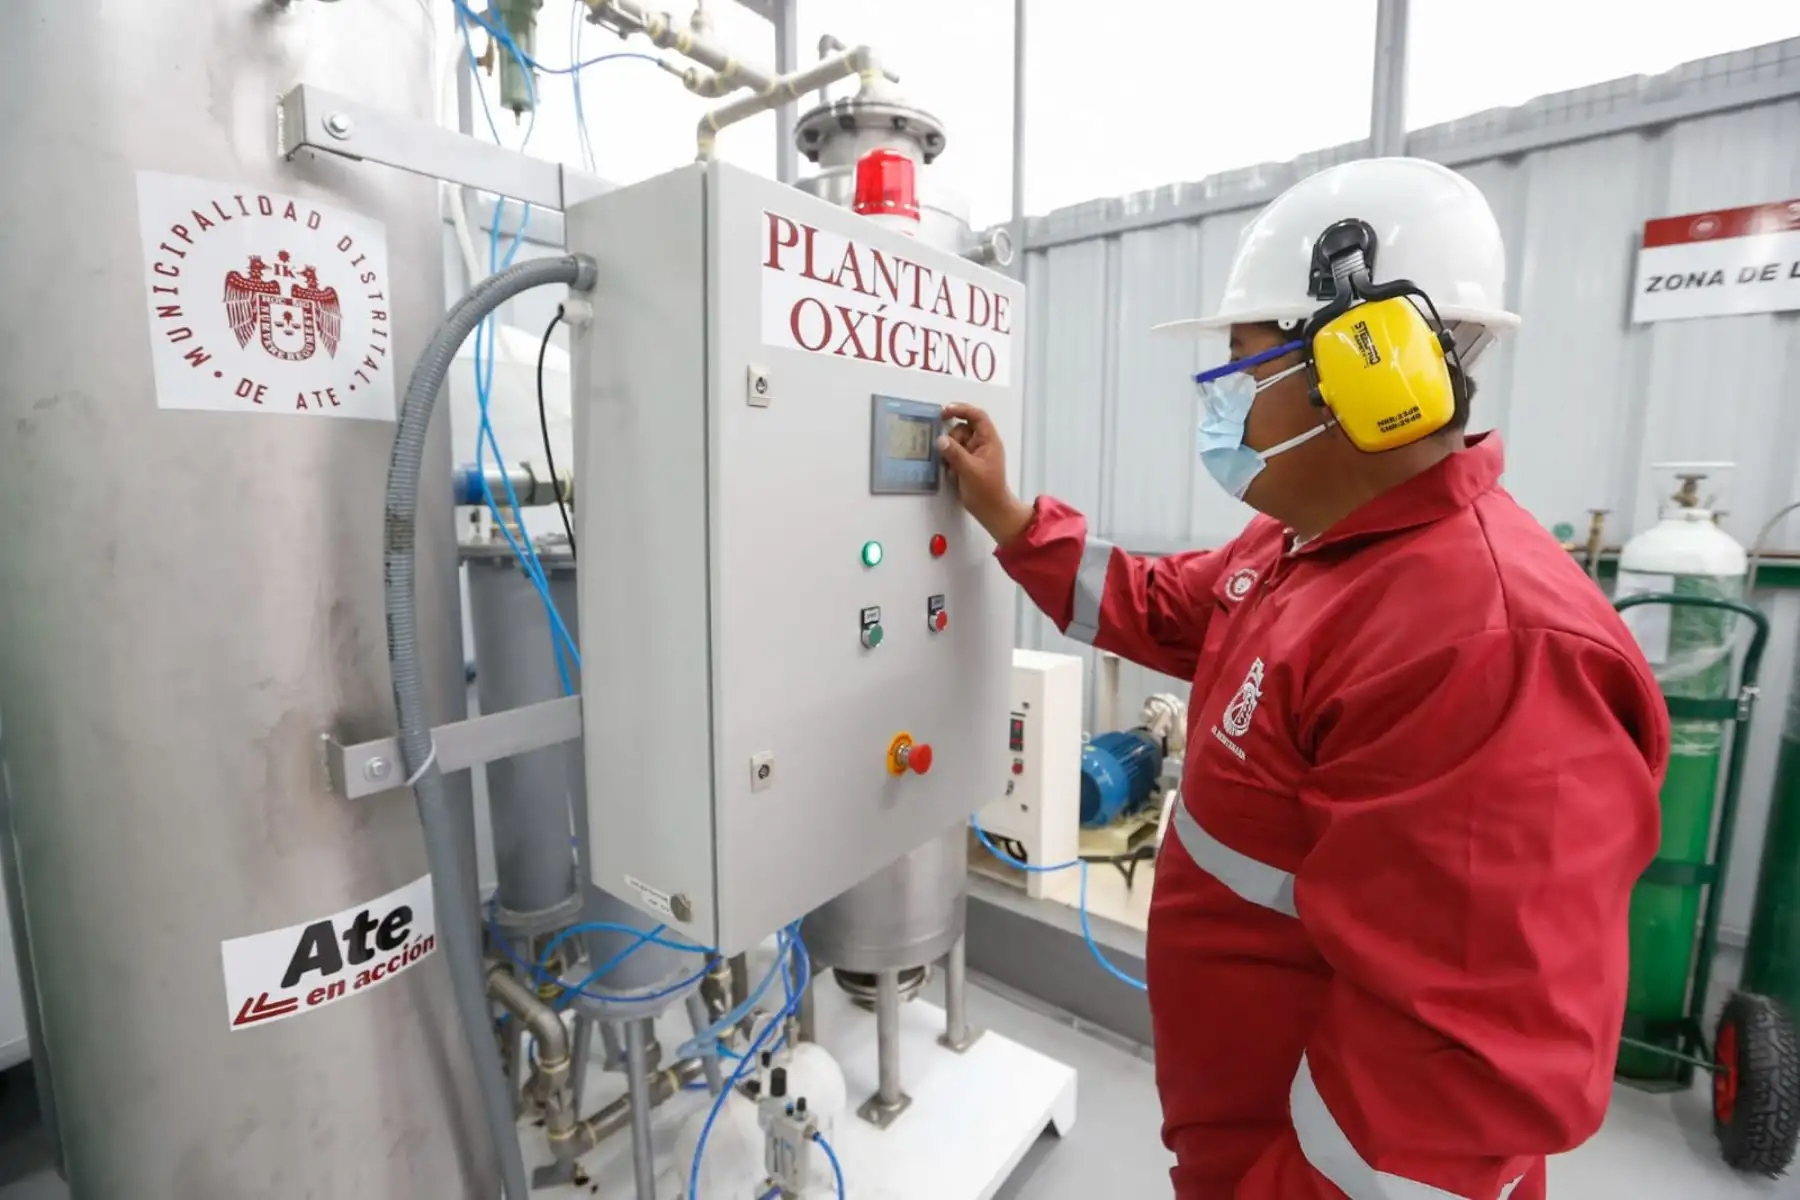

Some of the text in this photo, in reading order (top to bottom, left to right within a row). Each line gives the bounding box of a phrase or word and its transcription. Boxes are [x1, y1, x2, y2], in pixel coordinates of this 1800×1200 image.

[153, 195, 321, 368] MUNICIPALIDAD
[336, 235, 388, 385] DISTRITAL
[763, 210, 1011, 335] PLANTA DE
[1645, 269, 1725, 293] ZONA
[1736, 262, 1781, 284] DE
[790, 297, 996, 382] OXÍGENO
[234, 377, 341, 410] DE ATE
[280, 905, 414, 989] Ate
[306, 933, 436, 1006] en acción
